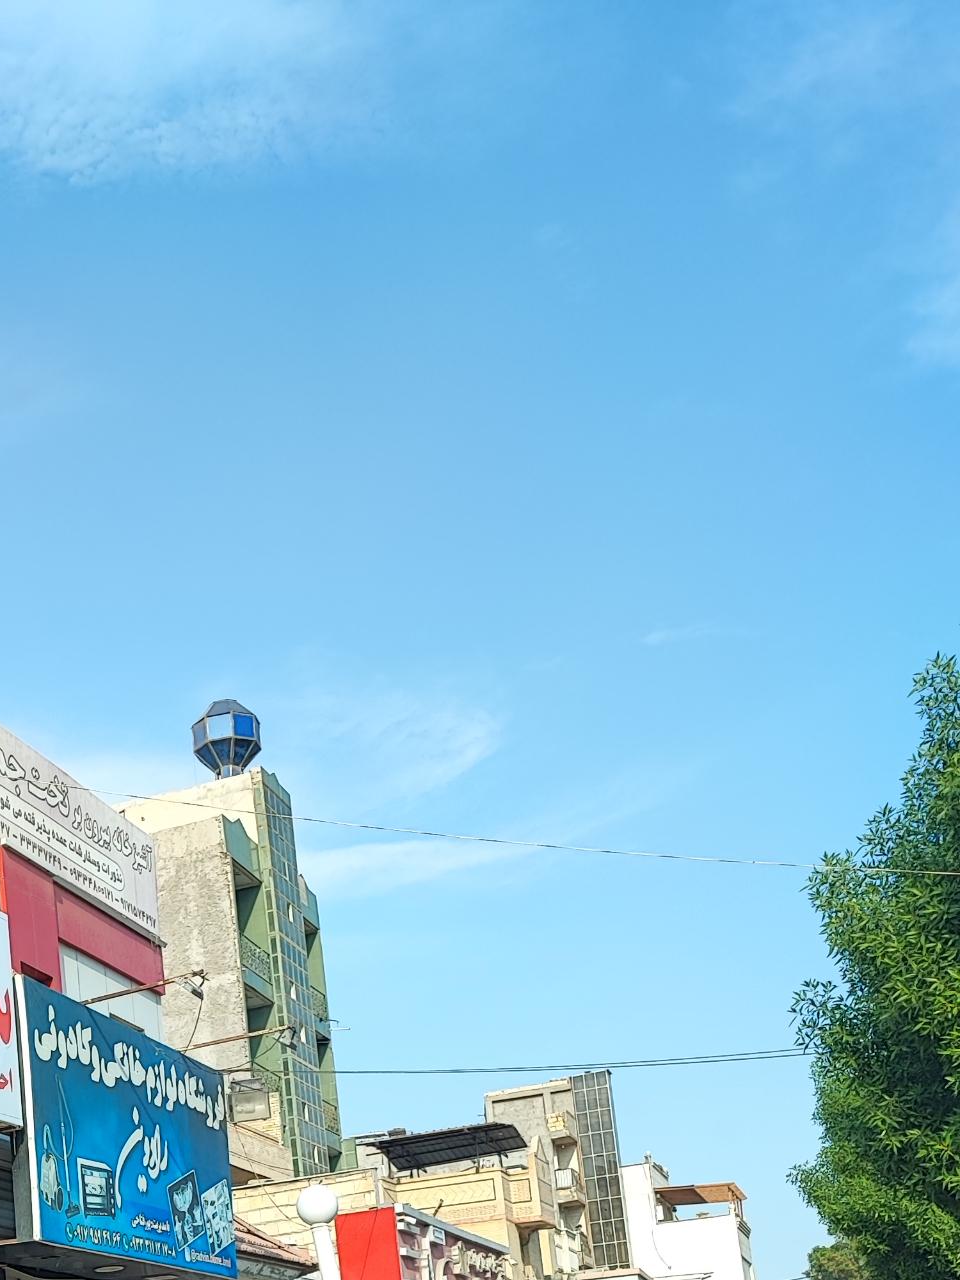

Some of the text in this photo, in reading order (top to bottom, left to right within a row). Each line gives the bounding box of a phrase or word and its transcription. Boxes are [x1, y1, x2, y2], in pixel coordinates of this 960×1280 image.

[101, 1041, 146, 1088] خانگی
[146, 1060, 177, 1112] لوازم
[178, 1071, 226, 1131] فروشگاه
